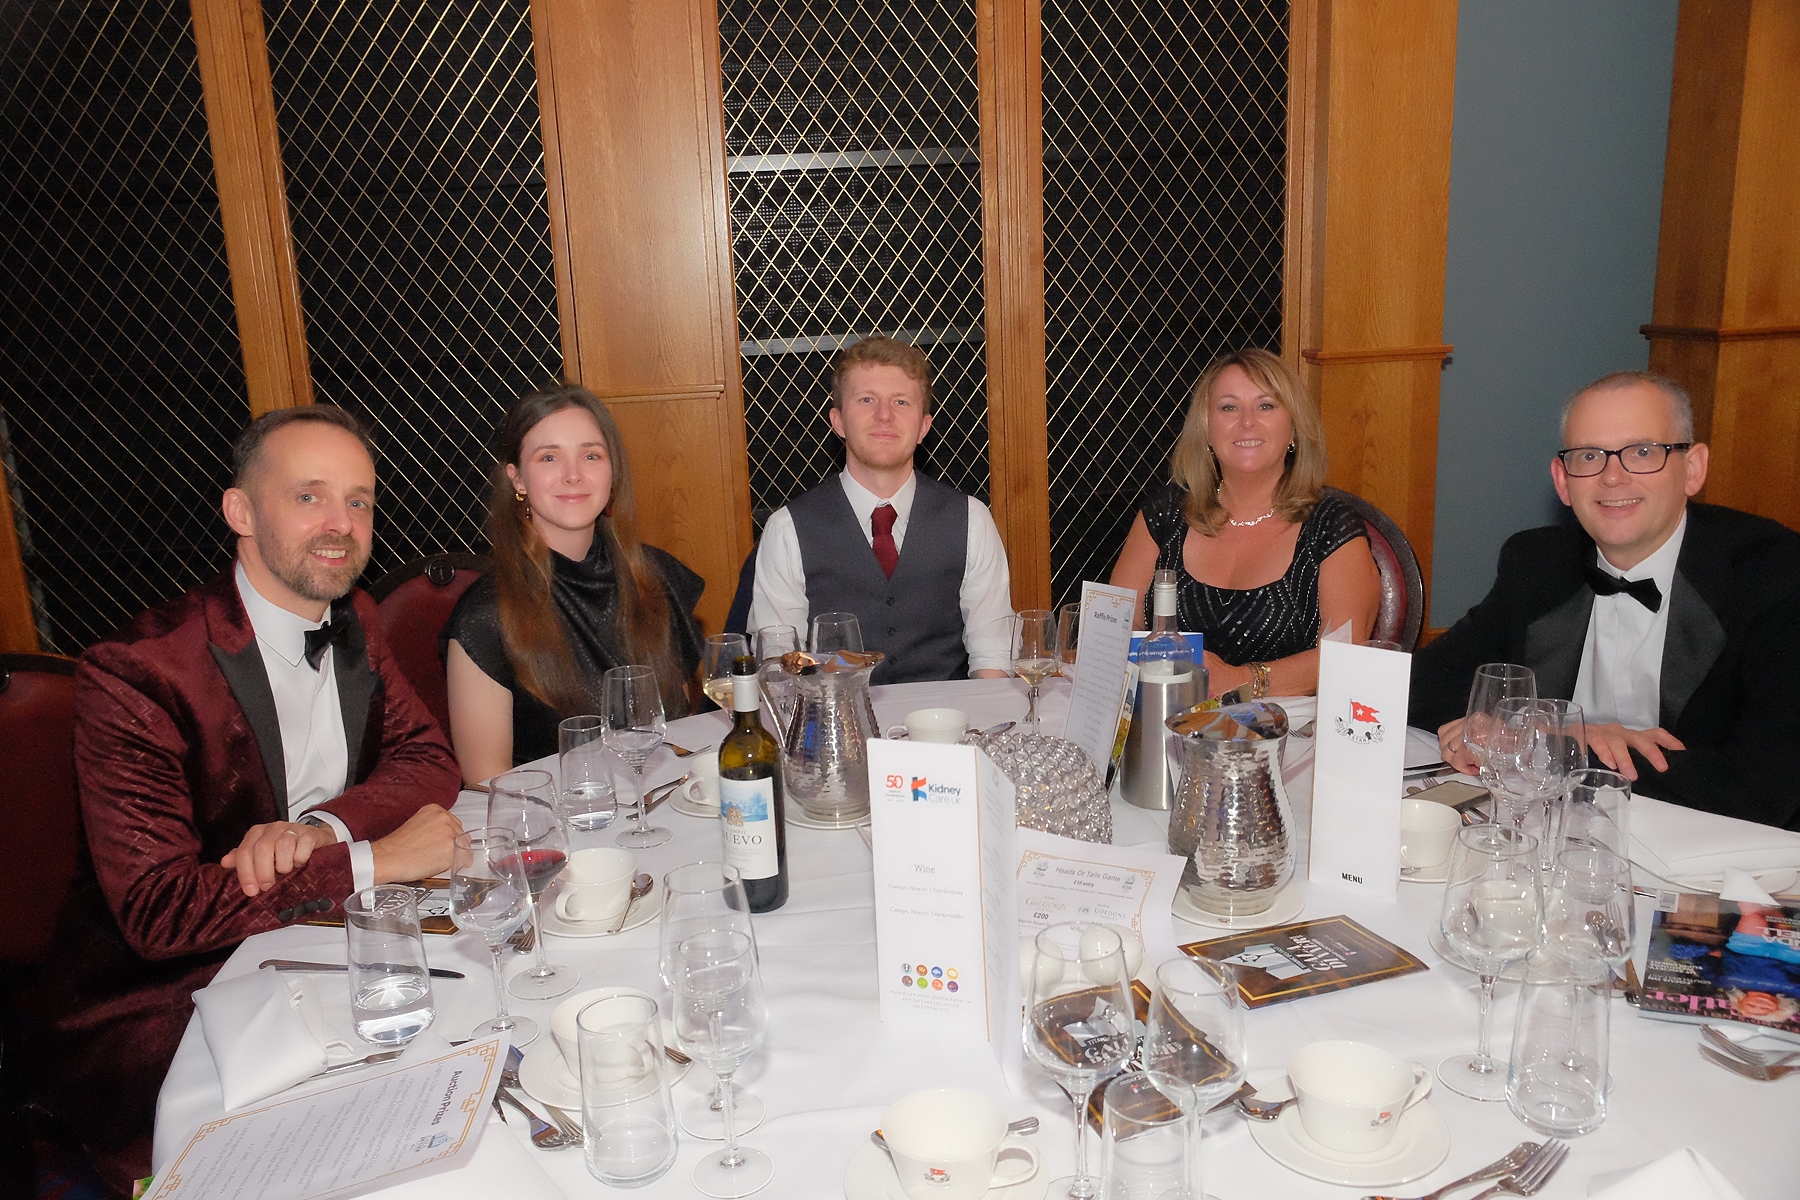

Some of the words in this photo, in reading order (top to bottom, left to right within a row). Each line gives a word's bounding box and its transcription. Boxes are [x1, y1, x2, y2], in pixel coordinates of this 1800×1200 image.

[1094, 611, 1106, 621] Raffle
[885, 774, 904, 789] 50
[928, 783, 961, 796] Kidney
[928, 793, 951, 804] Care
[914, 864, 936, 874] Wine
[1055, 866, 1076, 876] Heads
[1076, 869, 1086, 877] Or
[1086, 870, 1101, 879] Tails
[1102, 873, 1121, 882] Game
[1341, 871, 1363, 885] MENU
[1033, 911, 1049, 920] £200
[1094, 907, 1126, 918] GORDONS
[1287, 945, 1329, 971] GALA
[443, 1071, 462, 1100] Auction
[430, 1101, 450, 1125] Prizes
